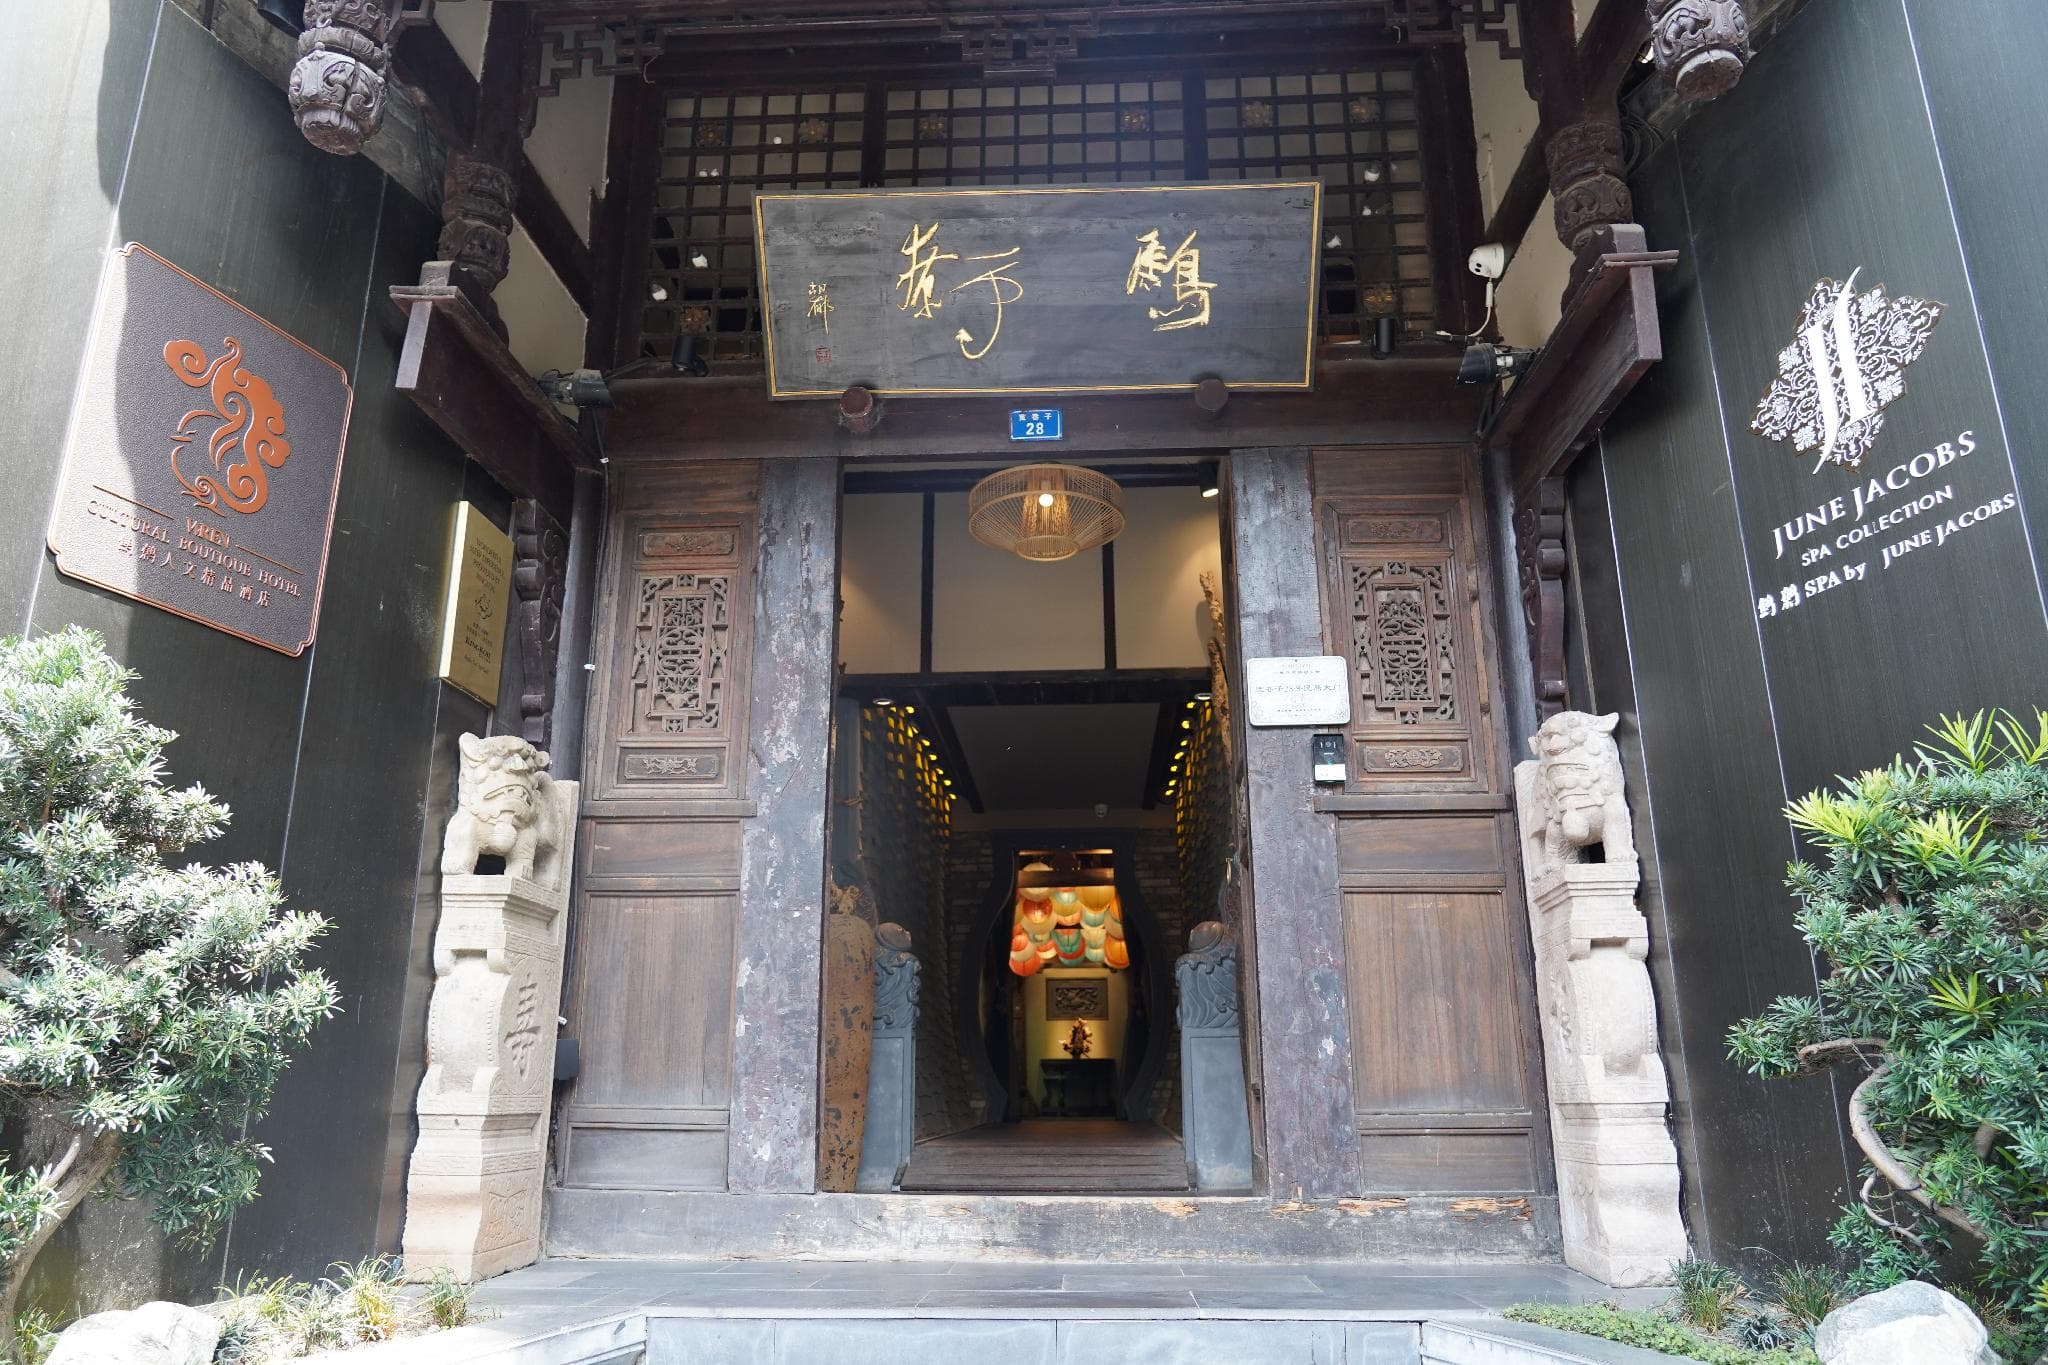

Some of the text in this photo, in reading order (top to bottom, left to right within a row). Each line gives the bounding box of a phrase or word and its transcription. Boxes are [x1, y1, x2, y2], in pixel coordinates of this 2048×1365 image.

[1026, 422, 1044, 436] 28
[1772, 430, 1977, 560] JUNE JACOBS
[1801, 484, 1954, 568] SPA COLLECTION
[85, 499, 302, 598] CULTURAL BOUTIQUE HOTEL
[1804, 571, 1842, 599] SPA
[1844, 562, 1867, 581] by
[1881, 529, 1933, 570] JUNE
[1935, 493, 2018, 547] JACOBS
